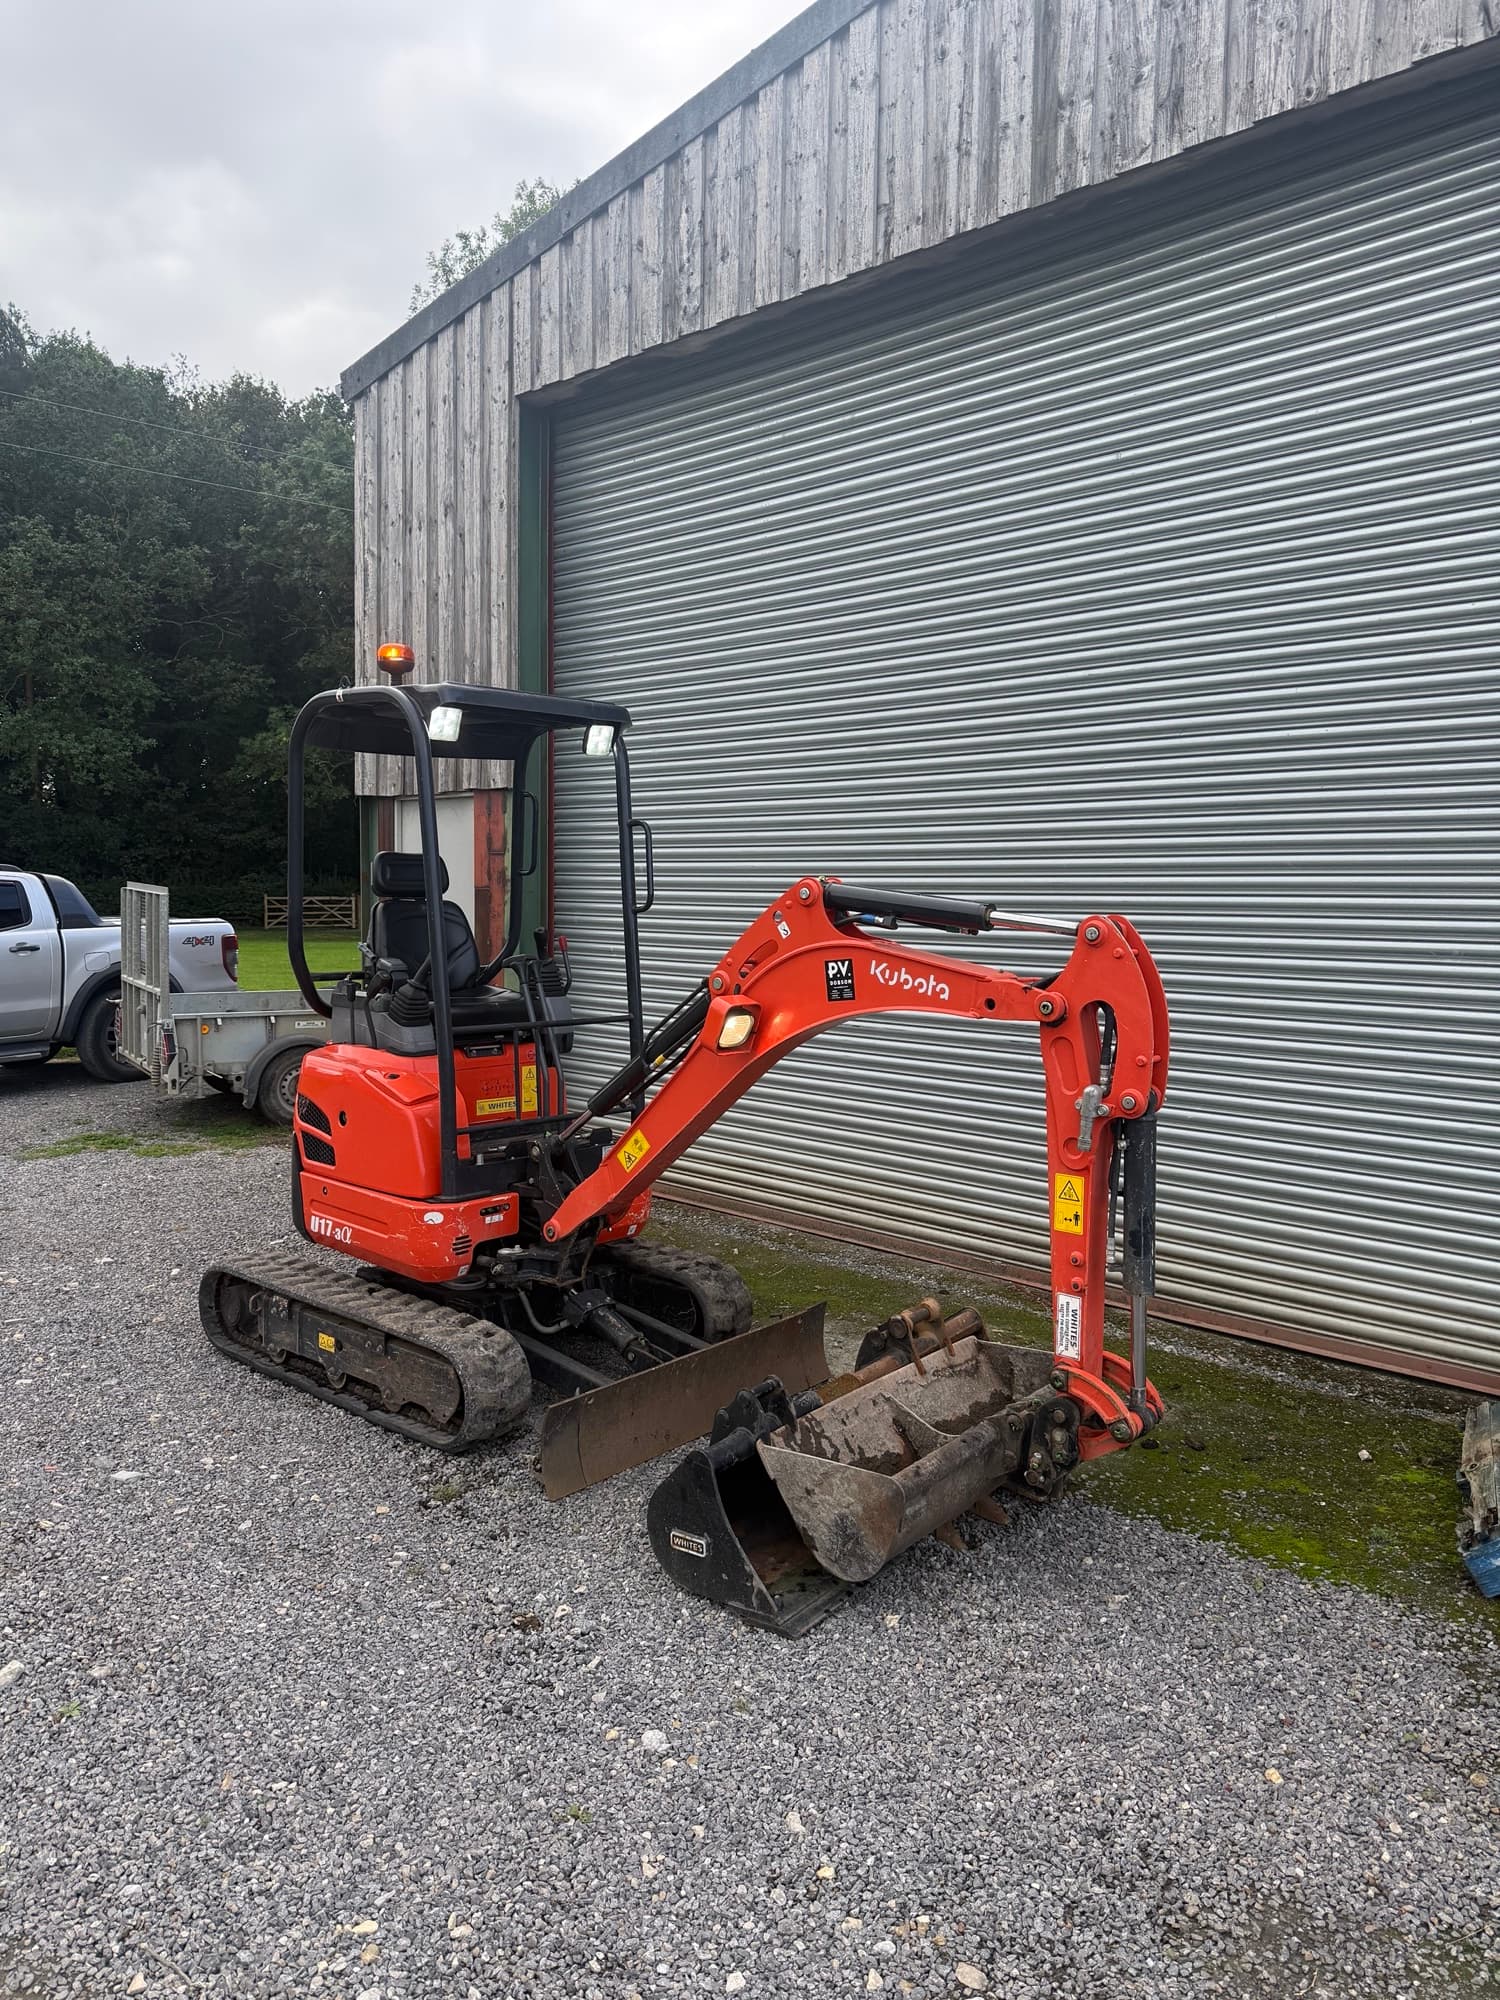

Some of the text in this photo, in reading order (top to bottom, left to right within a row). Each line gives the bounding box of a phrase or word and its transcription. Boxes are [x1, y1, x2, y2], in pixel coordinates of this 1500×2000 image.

[828, 960, 852, 978] P.V.
[870, 959, 950, 1001] Kubota
[1070, 1308, 1078, 1348] WHITES
[673, 1536, 703, 1552] WHITES
